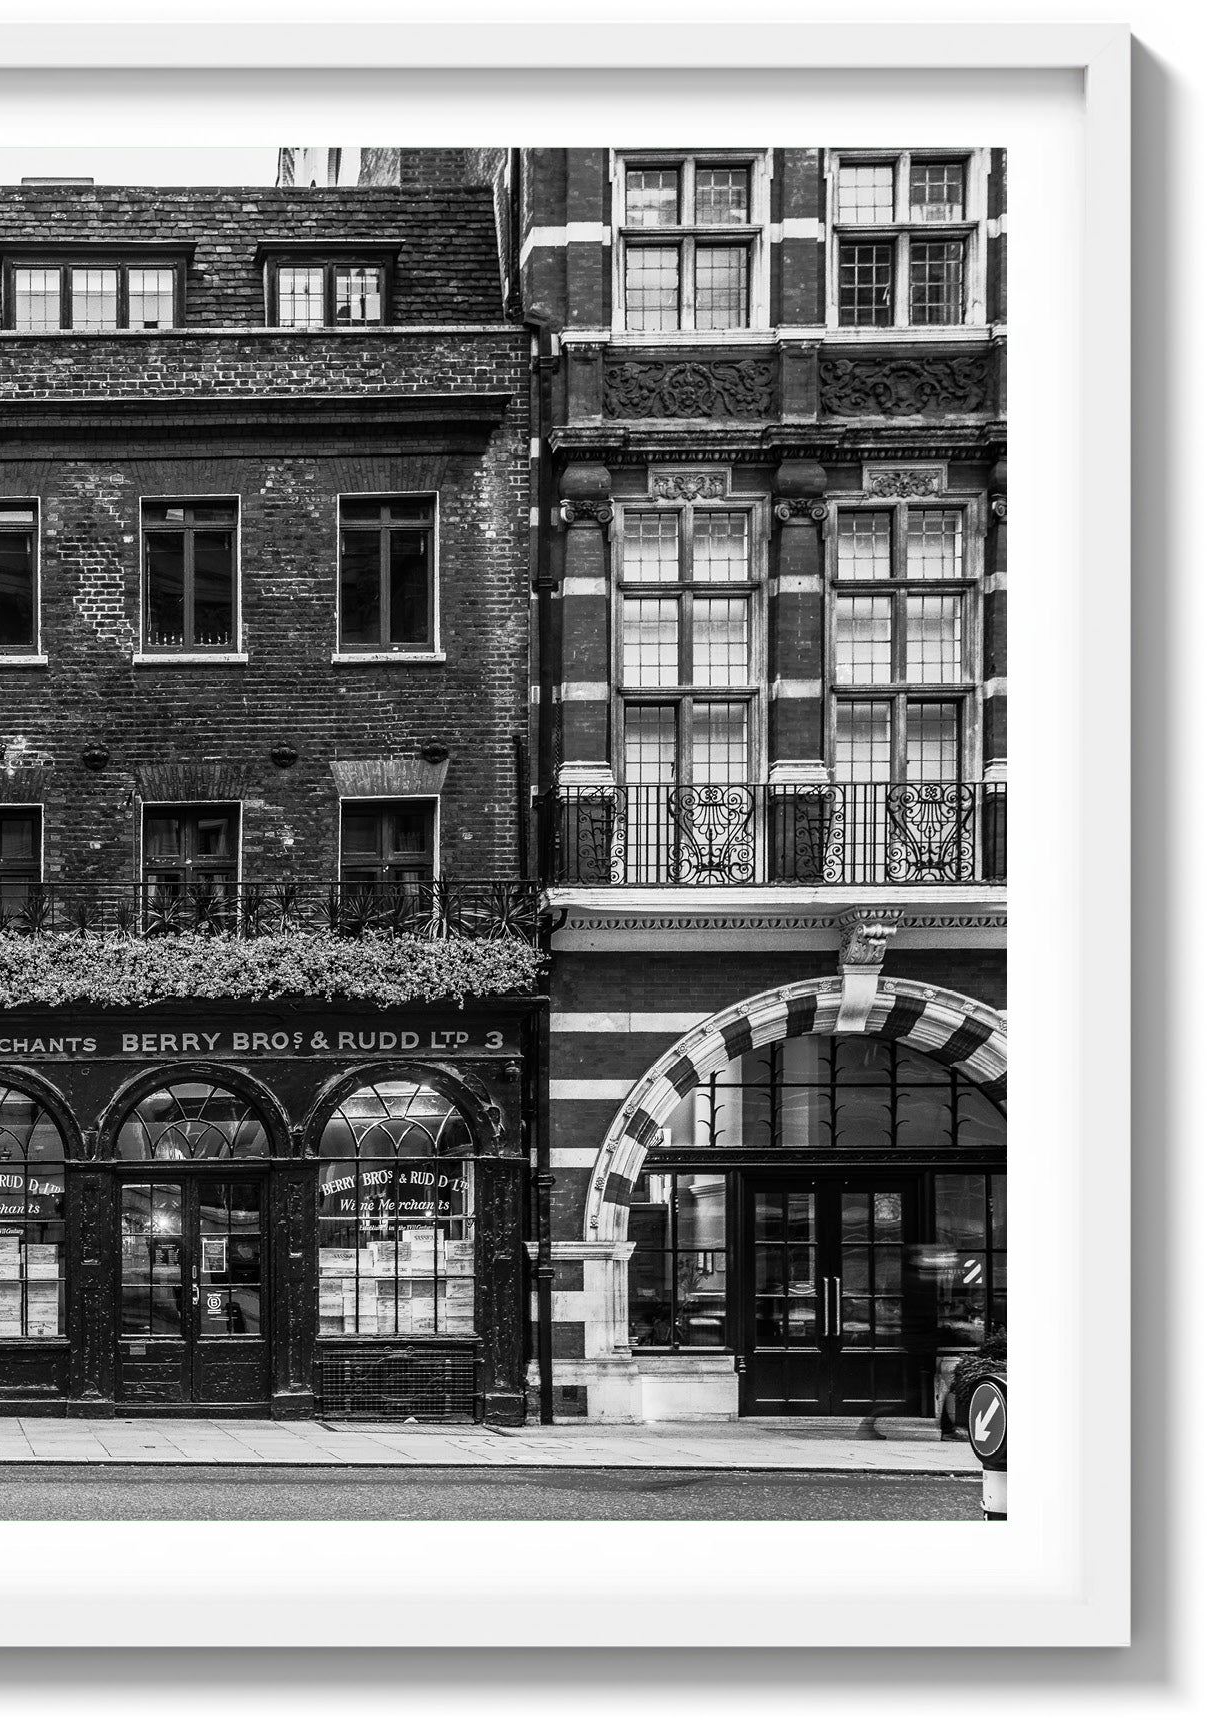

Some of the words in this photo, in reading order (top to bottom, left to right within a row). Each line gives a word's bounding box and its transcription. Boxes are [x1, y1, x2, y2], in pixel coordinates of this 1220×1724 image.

[122, 1032, 222, 1052] BERRY
[310, 1031, 330, 1050] &
[338, 1031, 420, 1050] RUDD
[484, 1030, 504, 1050] 3
[321, 1175, 356, 1196] BERRY
[398, 1173, 407, 1184] &
[410, 1170, 448, 1188] RUDD
[340, 1199, 375, 1211] Wine
[378, 1198, 450, 1211] Merchants
